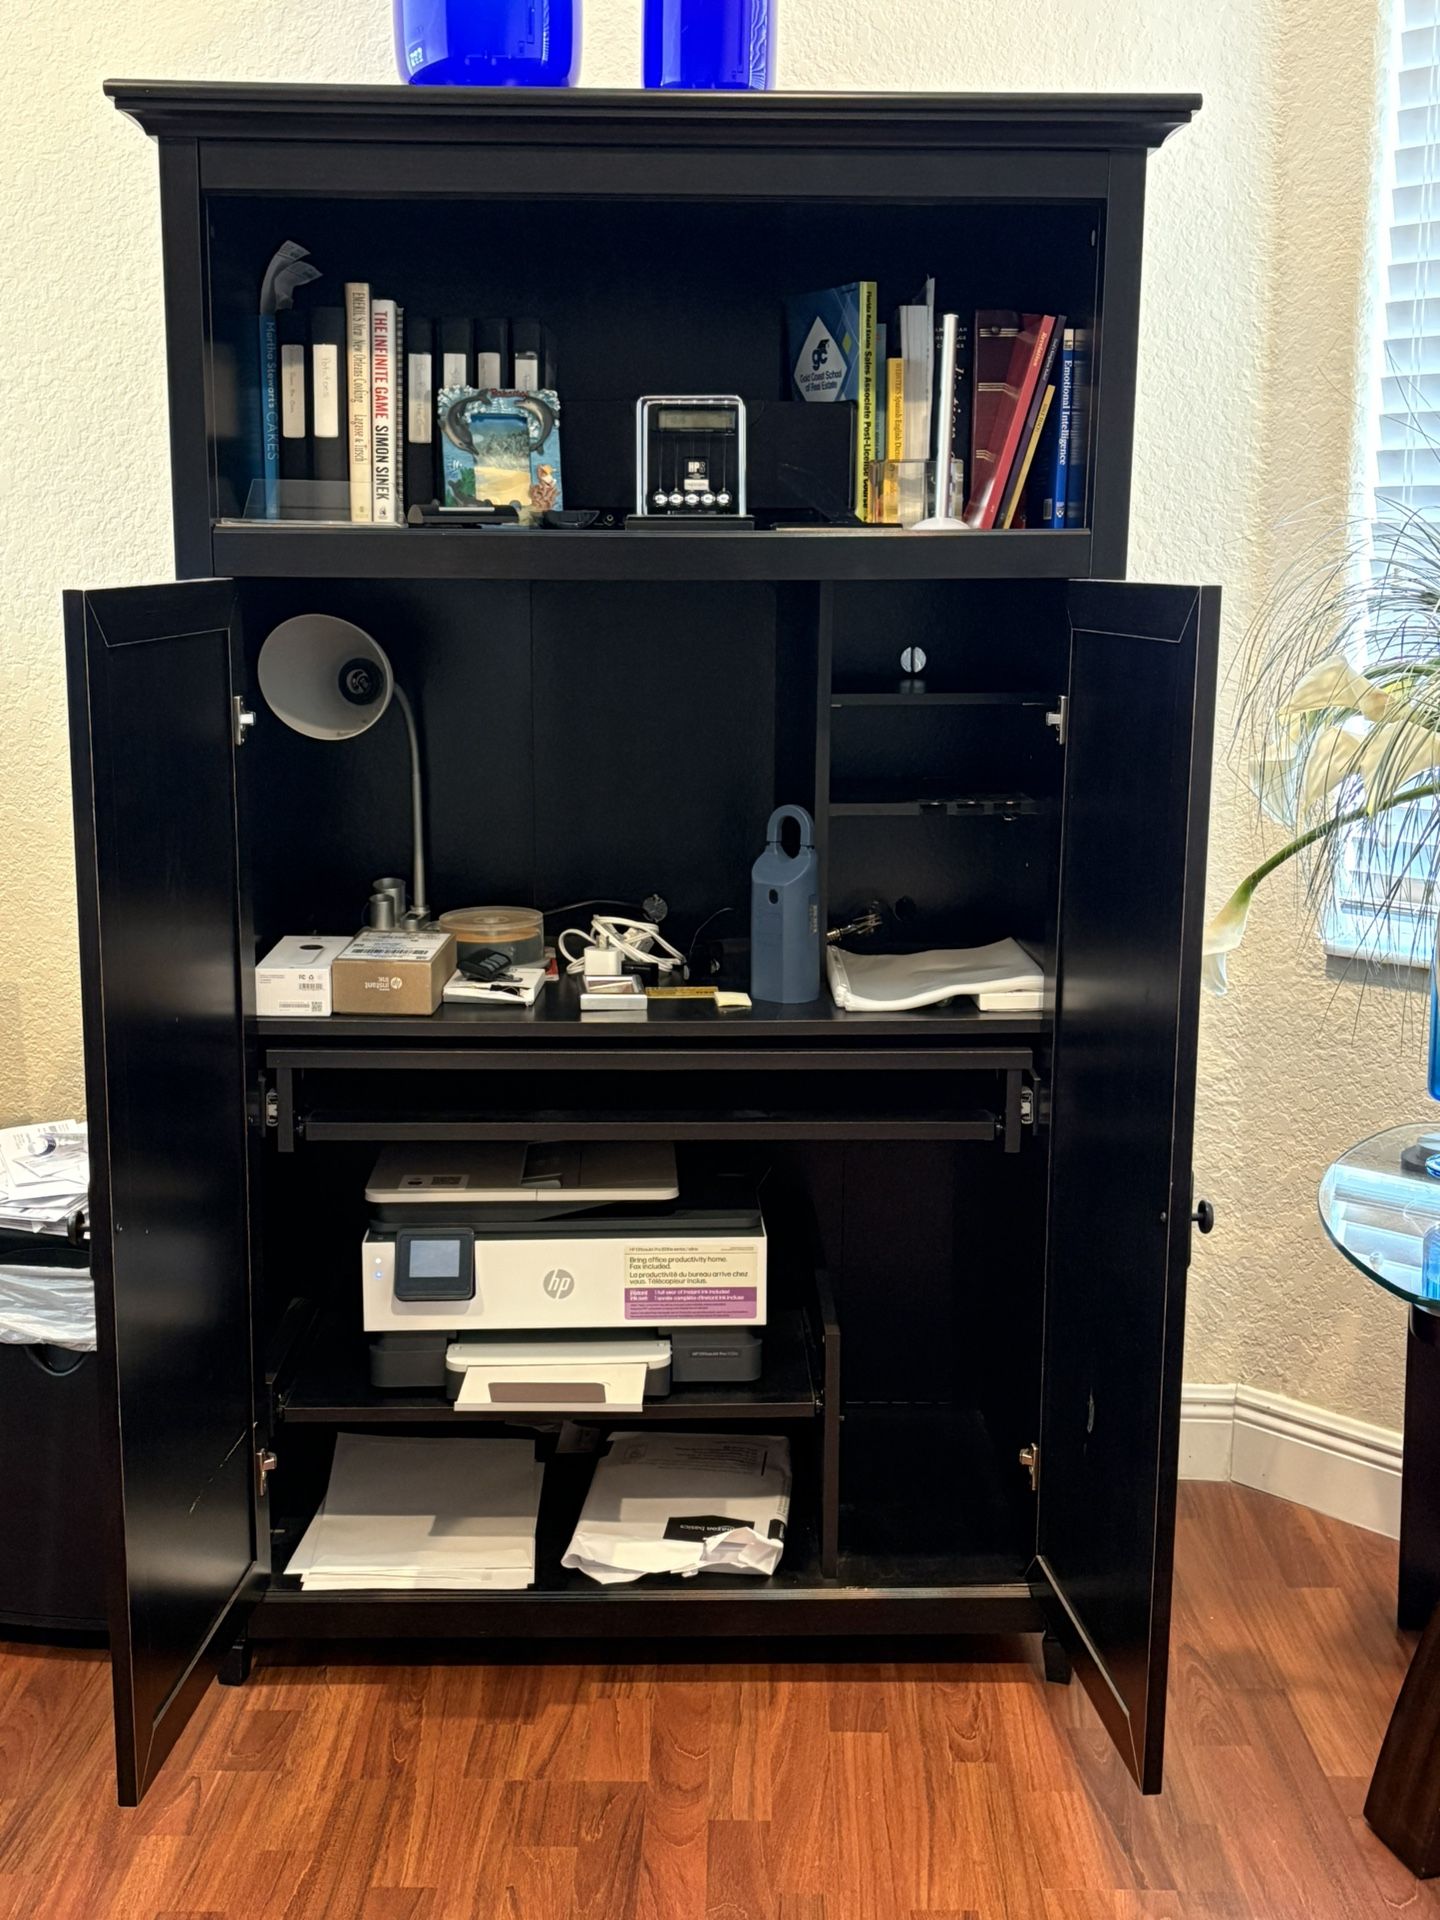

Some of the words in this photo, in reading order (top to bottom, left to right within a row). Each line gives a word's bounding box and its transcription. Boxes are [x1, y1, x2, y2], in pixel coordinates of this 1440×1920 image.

[353, 323, 366, 336] New
[374, 311, 388, 333] THE
[266, 322, 276, 360] Martha
[353, 339, 366, 353] New
[1033, 331, 1047, 367] Revelation
[354, 354, 367, 377] Orleans
[374, 334, 389, 383] INFINITE
[864, 351, 873, 375] Sales
[800, 374, 810, 383] Gold
[811, 372, 825, 381] Coast
[825, 370, 842, 380] School
[805, 383, 811, 392] of
[811, 382, 821, 391] Real
[822, 381, 838, 390] Estate
[1062, 360, 1072, 409] Emotional
[351, 378, 368, 403] Cooking
[374, 386, 389, 419] GAME
[864, 377, 872, 419] Associate
[893, 395, 902, 419] Spanish
[267, 411, 280, 461] CAKES
[351, 414, 367, 438] Lagasse
[893, 419, 902, 441] English
[375, 425, 390, 463] SIMON
[863, 421, 872, 477] Post-License
[1059, 411, 1070, 466] Intelligence
[354, 444, 368, 464] Tirsch
[375, 466, 390, 500] SINEK
[668, 1256, 706, 1264] productivity
[543, 1268, 575, 1299] hp
[638, 1271, 677, 1279] productivité
